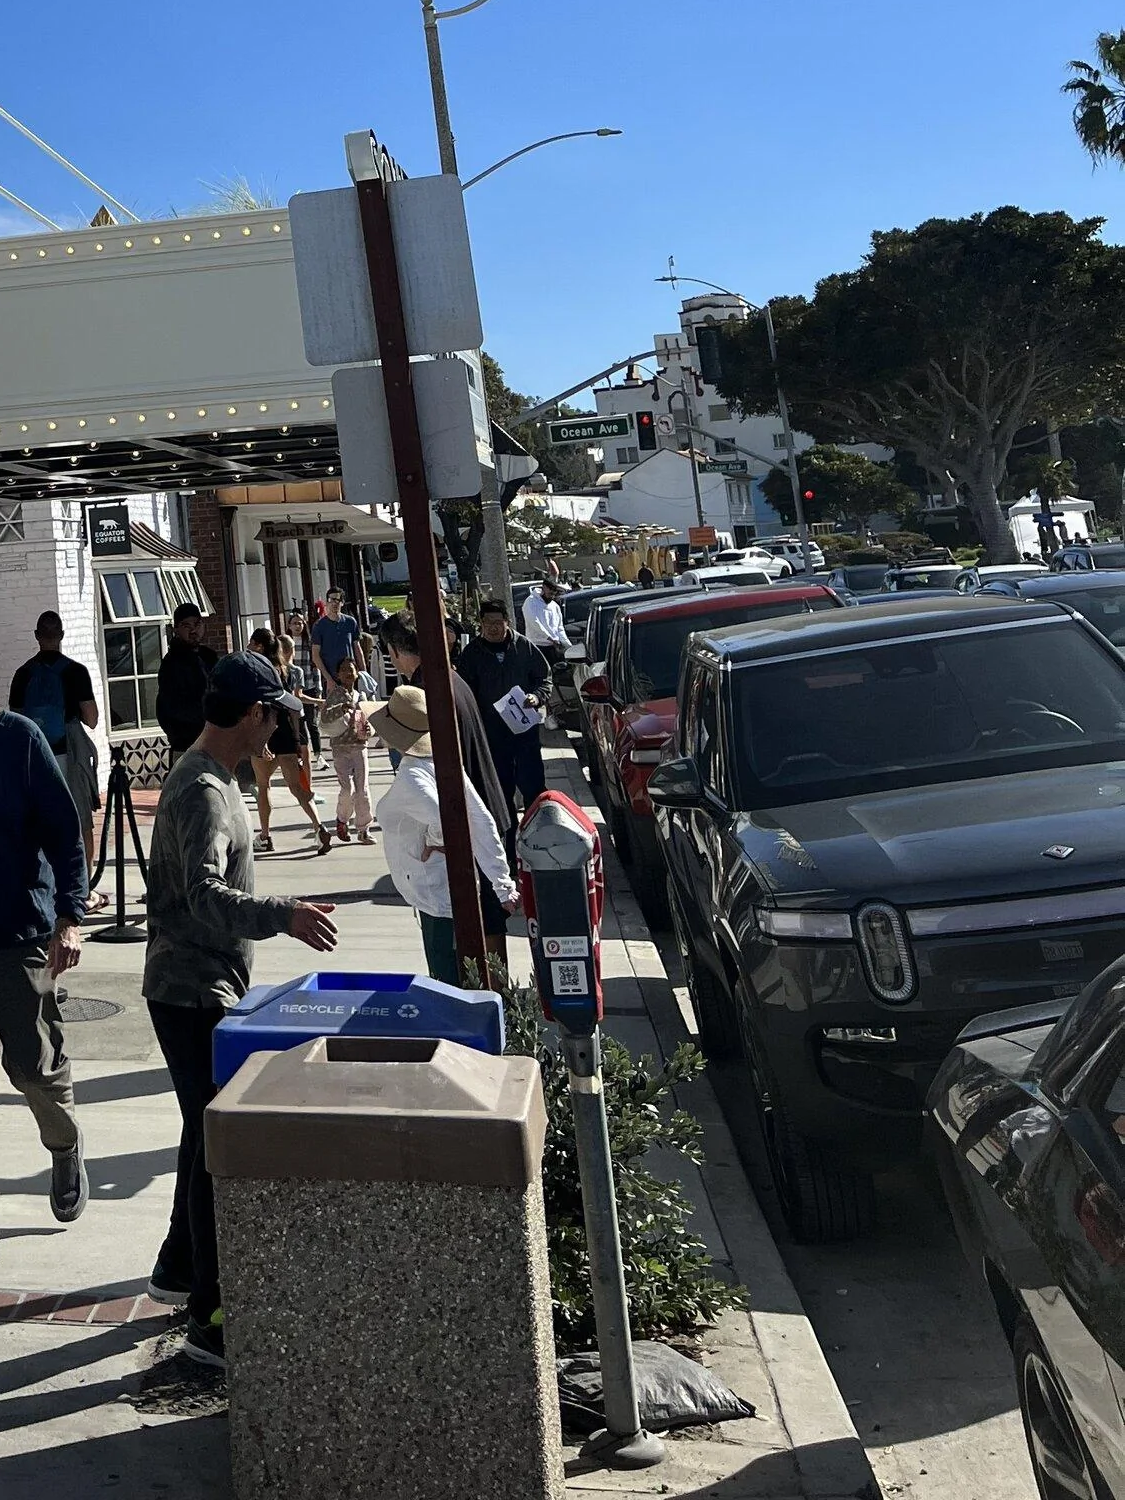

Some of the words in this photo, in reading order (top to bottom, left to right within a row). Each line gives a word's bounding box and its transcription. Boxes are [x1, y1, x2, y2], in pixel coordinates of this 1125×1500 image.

[560, 426, 594, 439] Ocean
[599, 423, 619, 435] Ave
[705, 463, 727, 472] Ocean
[729, 463, 741, 471] Ave
[95, 530, 125, 538] EQUATOR
[265, 524, 305, 538] Beach
[309, 522, 345, 536] Trade
[95, 536, 126, 544] COFFEES
[279, 1004, 345, 1014] RECYCLE
[351, 1006, 390, 1017] HERE
